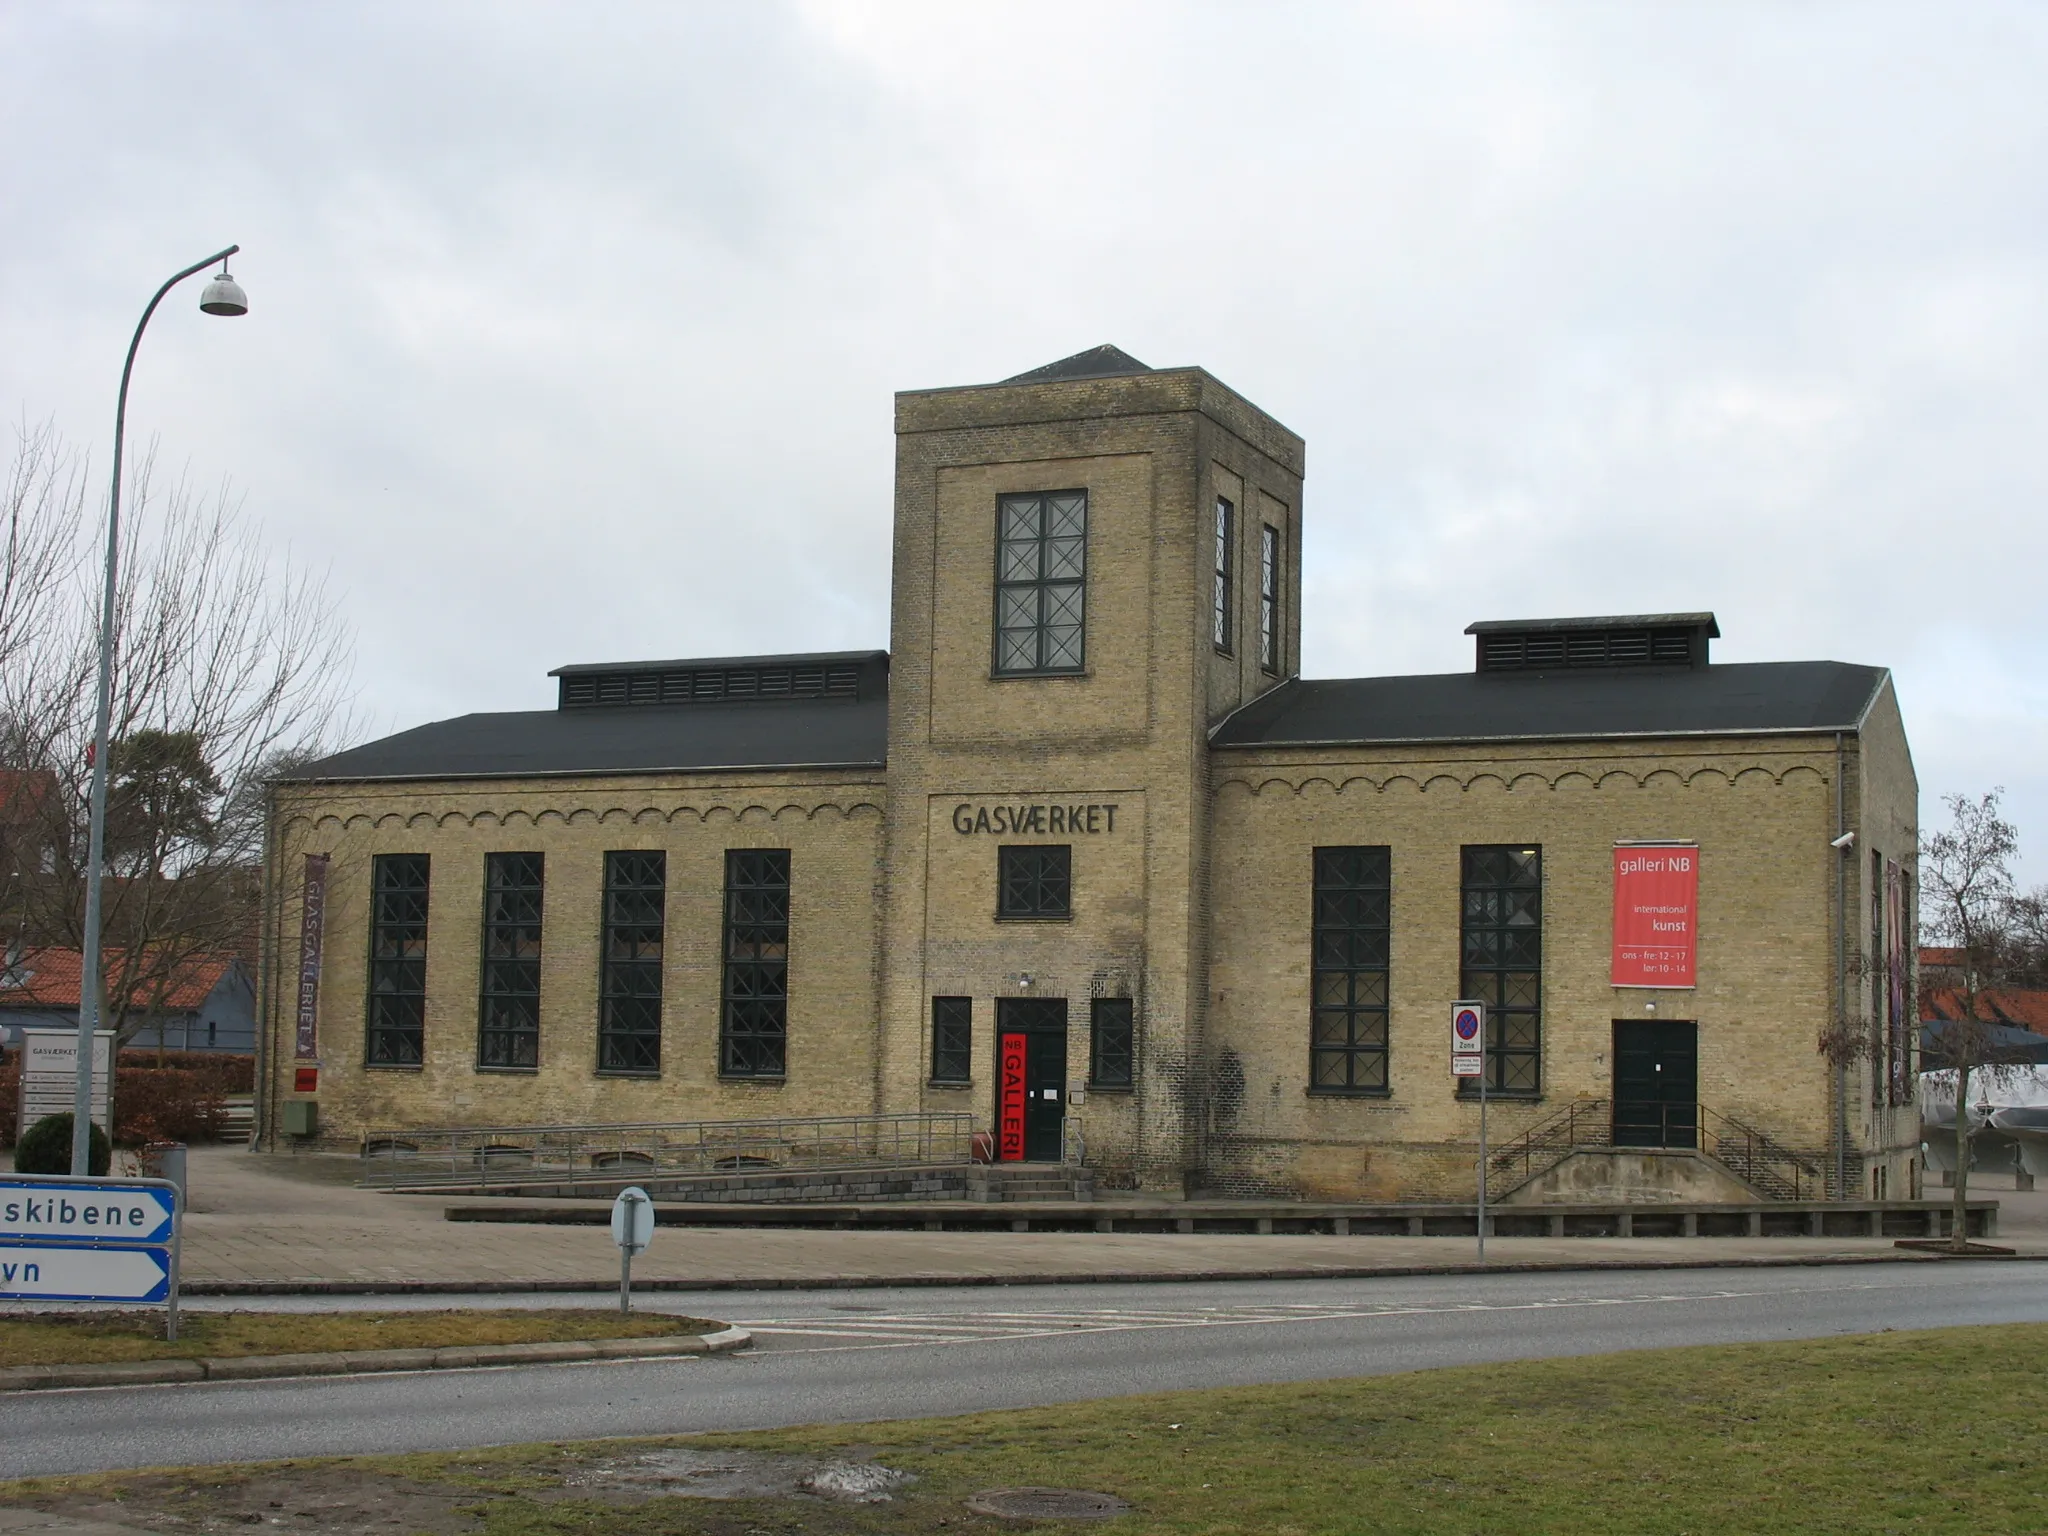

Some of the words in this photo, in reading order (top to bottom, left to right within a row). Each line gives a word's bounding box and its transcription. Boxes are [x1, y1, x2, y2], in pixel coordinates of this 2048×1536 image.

[952, 803, 1119, 835] GASVÆRKET
[1619, 857, 1665, 875] galleri
[1668, 857, 1690, 872] NB
[1634, 905, 1687, 914] international
[1652, 919, 1686, 932] kunst
[300, 880, 320, 1034] GLASGALLERIET
[1622, 952, 1637, 960] ons
[1643, 951, 1657, 960] fre:
[1659, 952, 1669, 960] 12
[1676, 952, 1685, 960] 17
[1659, 964, 1669, 973] 10
[1676, 964, 1686, 973] 14
[1005, 1041, 1022, 1050] NB
[1003, 1055, 1021, 1154] GALLERI
[4, 1198, 145, 1226] skibene
[2, 1263, 40, 1282] vn
